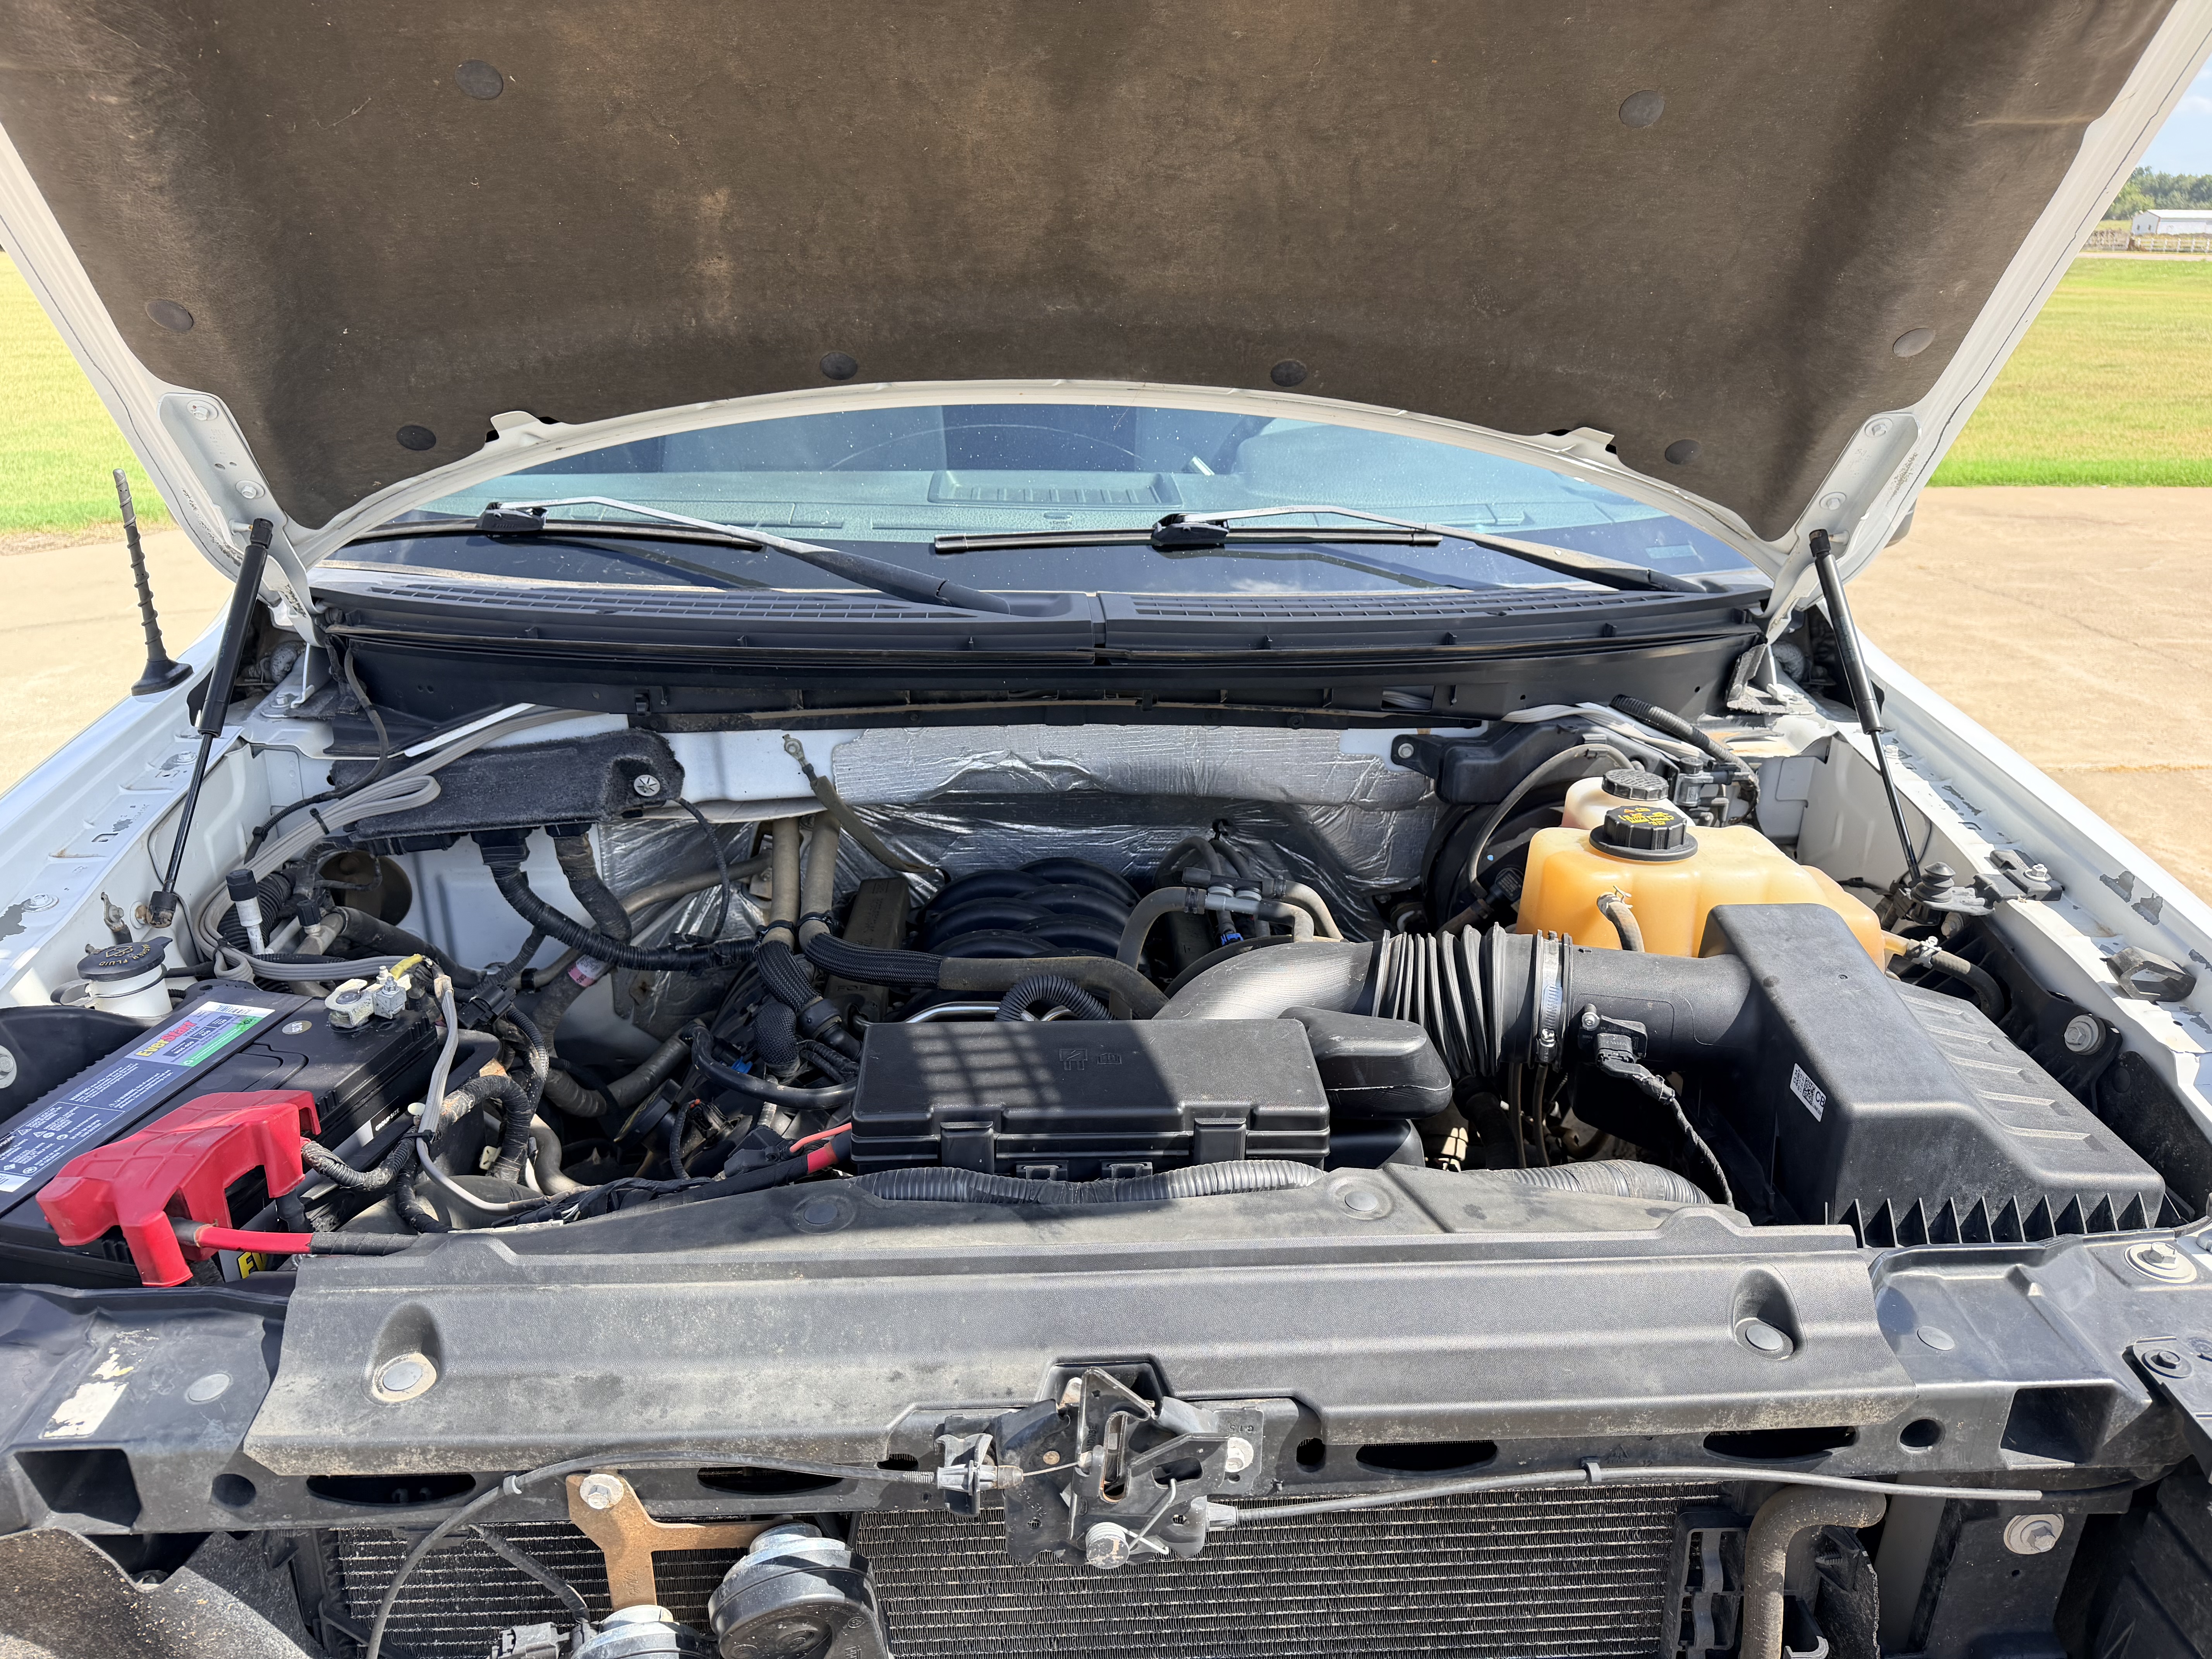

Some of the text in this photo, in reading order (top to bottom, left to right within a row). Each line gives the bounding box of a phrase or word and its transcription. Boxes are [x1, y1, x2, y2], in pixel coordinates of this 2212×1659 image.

[132, 944, 151, 960] WASHER
[136, 1020, 197, 1057] EverStart
[183, 1026, 200, 1036] VALUE
[1816, 1091, 1825, 1107] CB
[375, 1108, 400, 1131] GROUP SIZE
